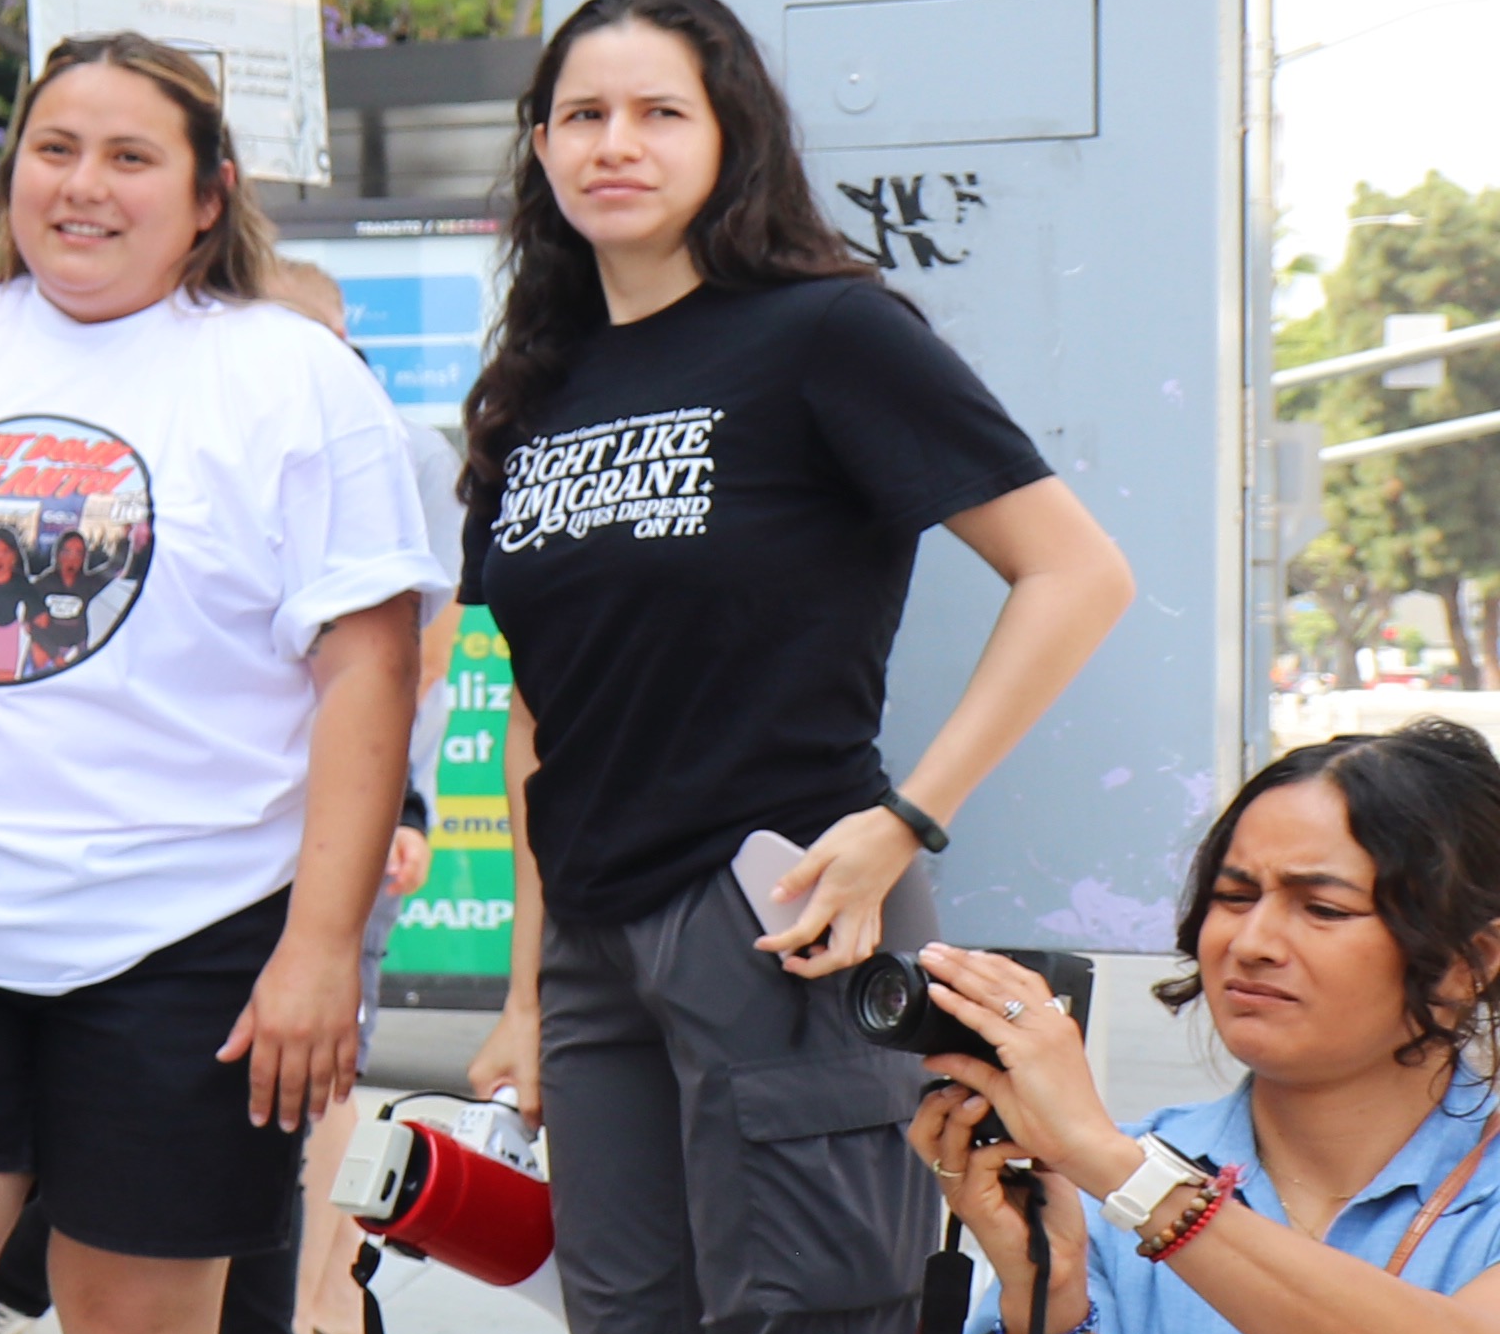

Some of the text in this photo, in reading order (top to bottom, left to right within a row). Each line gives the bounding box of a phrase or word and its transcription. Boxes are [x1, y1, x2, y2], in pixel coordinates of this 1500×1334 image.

[503, 419, 713, 490] FIGHT LIKE
[615, 496, 711, 523] DEPEND
[633, 515, 707, 539] ON IT.
[443, 730, 495, 763] at
[399, 898, 514, 930] AARP
